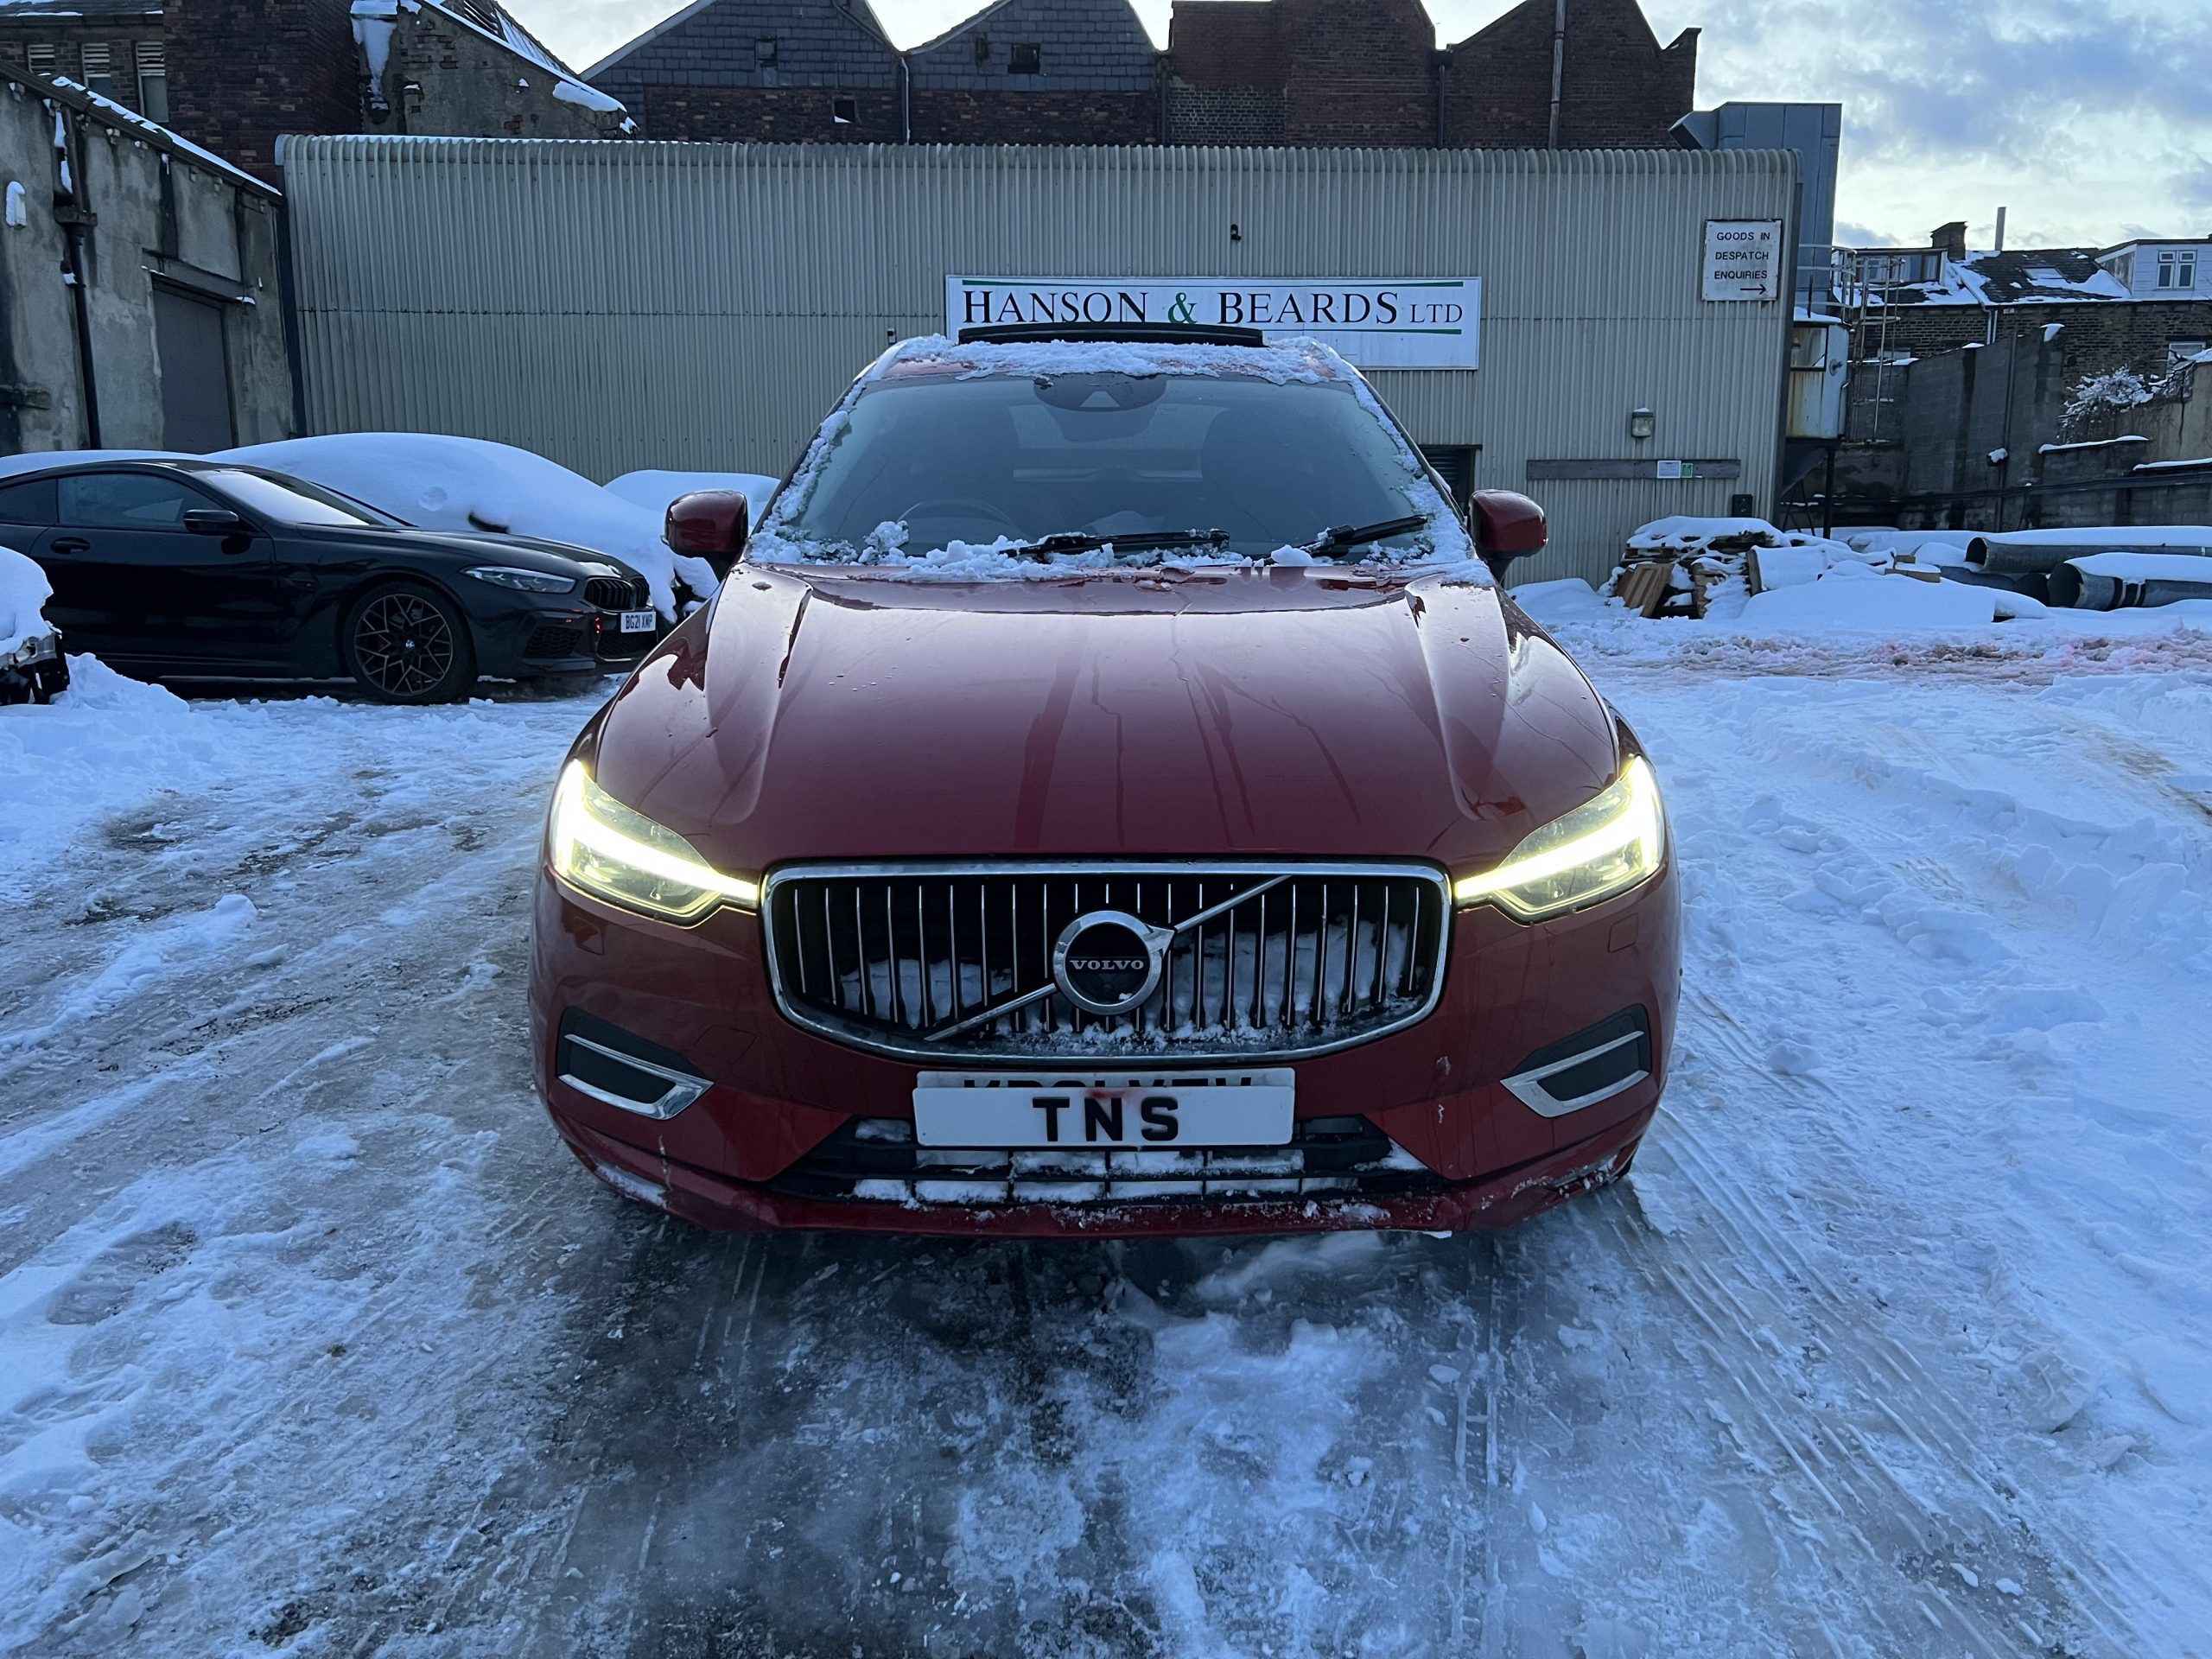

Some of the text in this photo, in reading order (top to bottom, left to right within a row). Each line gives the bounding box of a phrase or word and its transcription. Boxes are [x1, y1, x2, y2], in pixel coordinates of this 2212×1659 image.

[1716, 232, 1770, 241] GOODS IN
[1714, 251, 1769, 260] DESPATCH
[1713, 270, 1768, 280] ENQUIRIES
[963, 290, 1463, 325] HANSON & BEARDS LTD
[1069, 960, 1144, 969] VOLVO
[1032, 1096, 1179, 1142] TNS
